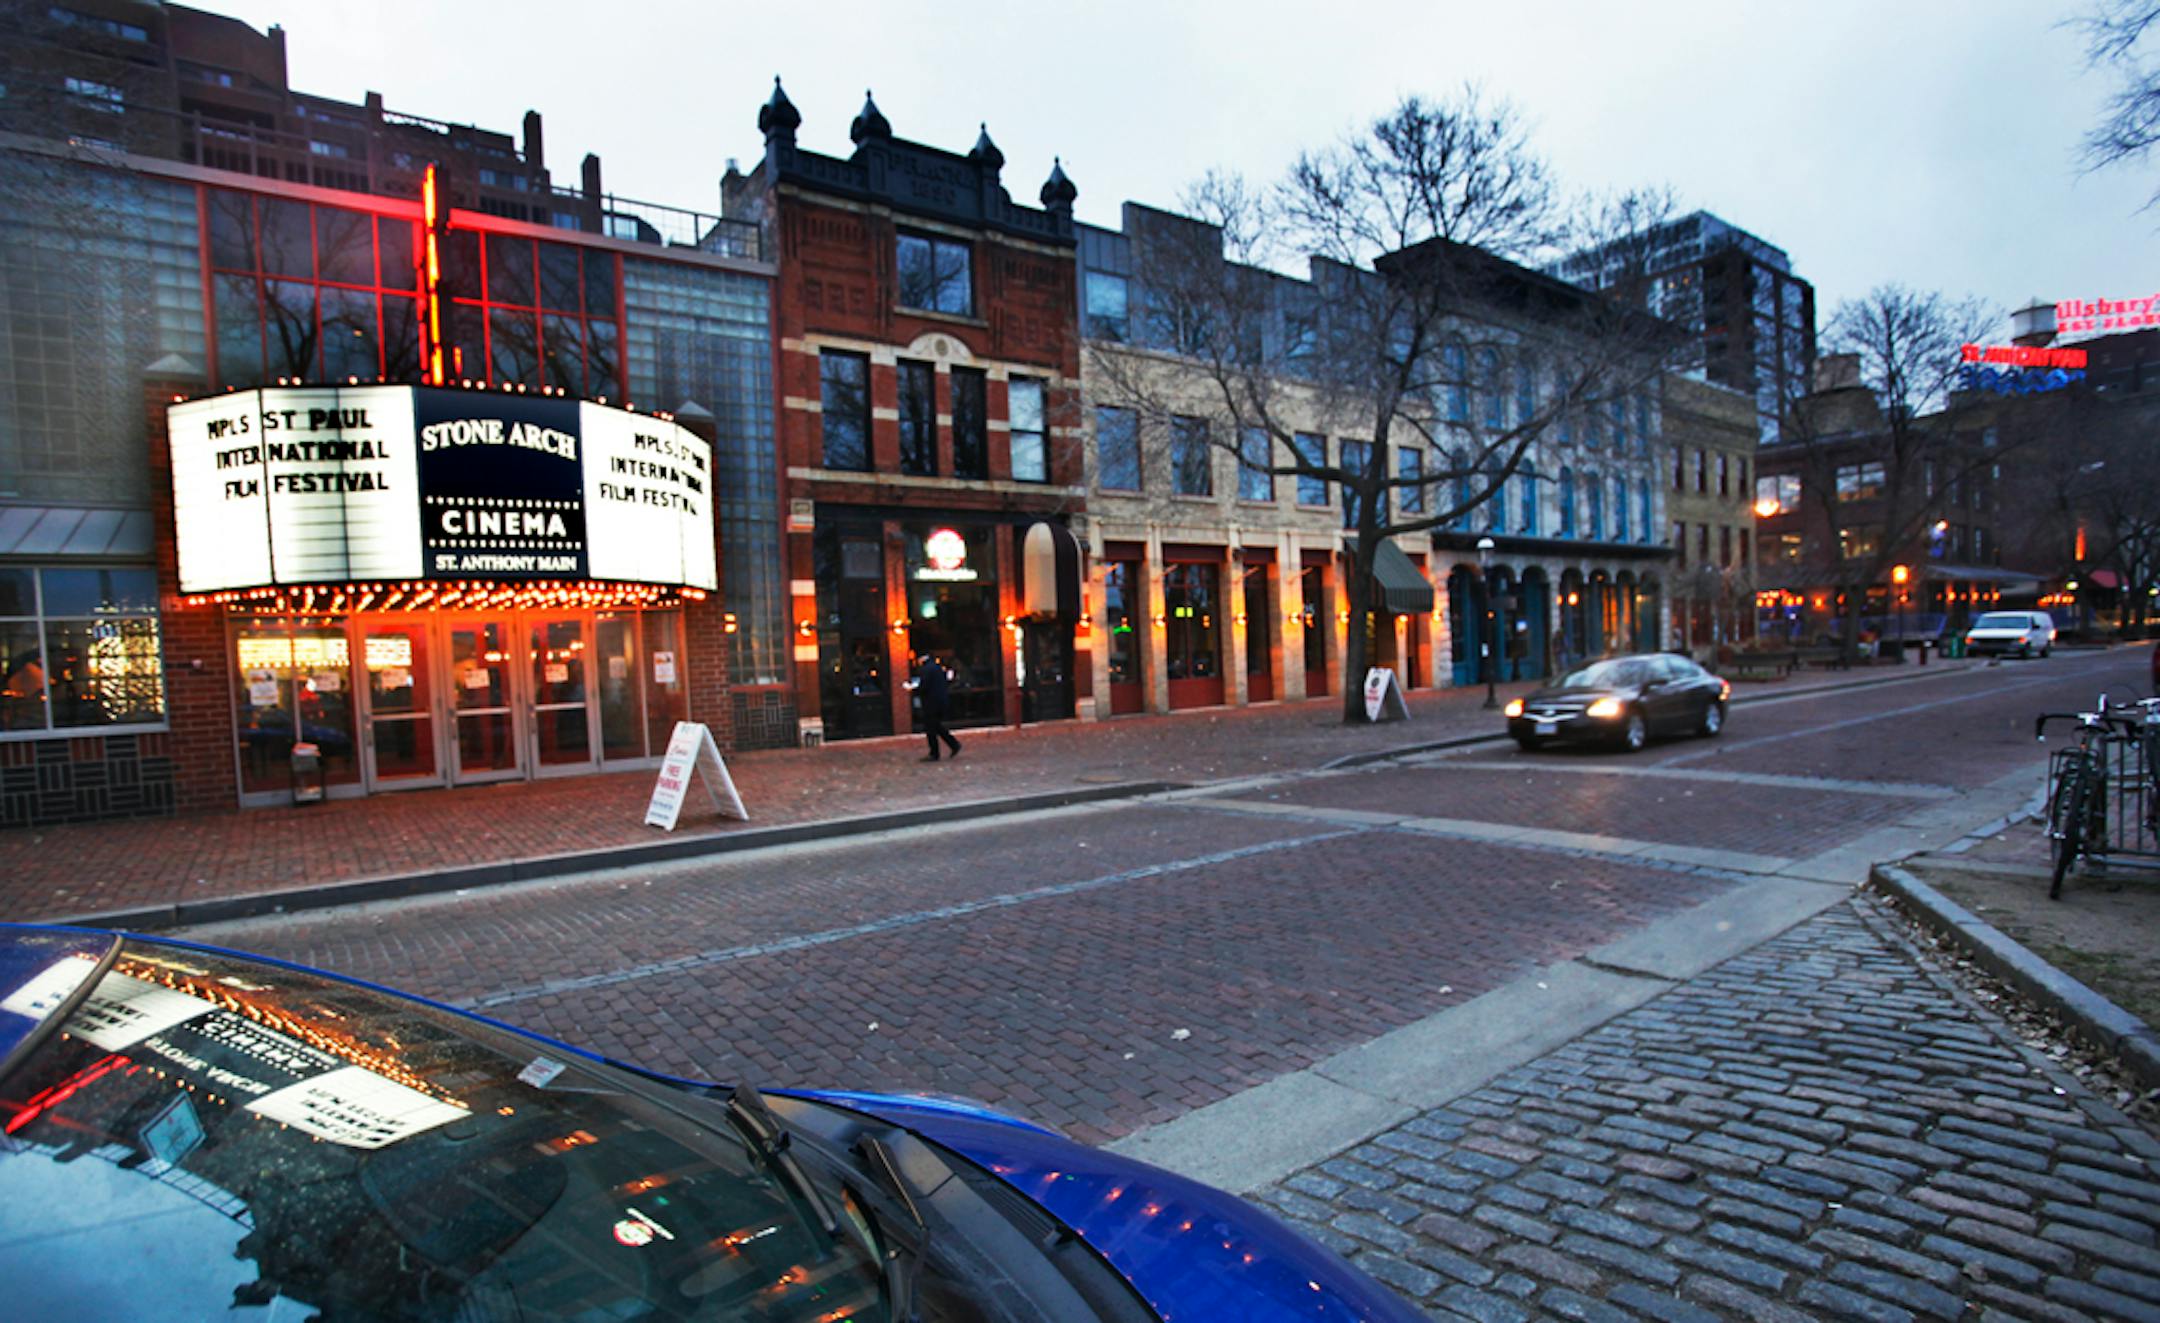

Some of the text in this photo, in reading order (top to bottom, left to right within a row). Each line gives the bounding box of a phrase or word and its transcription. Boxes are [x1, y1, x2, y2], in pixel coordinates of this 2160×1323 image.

[207, 407, 373, 439] MPLS ST PAUL
[421, 419, 577, 461] STONE ARCH
[225, 472, 390, 500] FILM FESTIVAL
[599, 481, 636, 503] FILM
[441, 509, 568, 537] CINEMA
[435, 554, 578, 572] ST. ANTHONY MAIN
